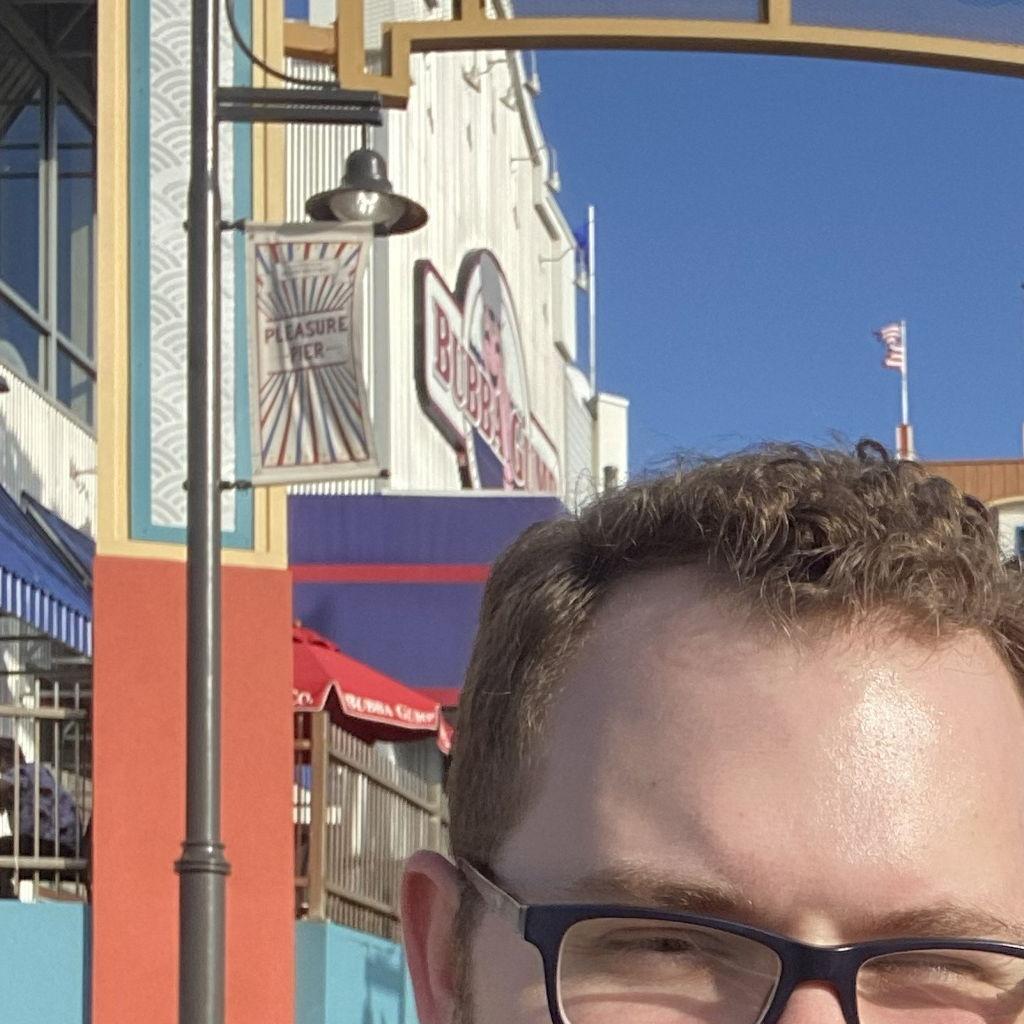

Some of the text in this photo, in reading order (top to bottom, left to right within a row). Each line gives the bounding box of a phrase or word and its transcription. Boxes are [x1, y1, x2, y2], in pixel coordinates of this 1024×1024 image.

[264, 316, 348, 344] PLEASURE
[290, 341, 324, 362] PIER
[344, 693, 393, 717] BUBBA
